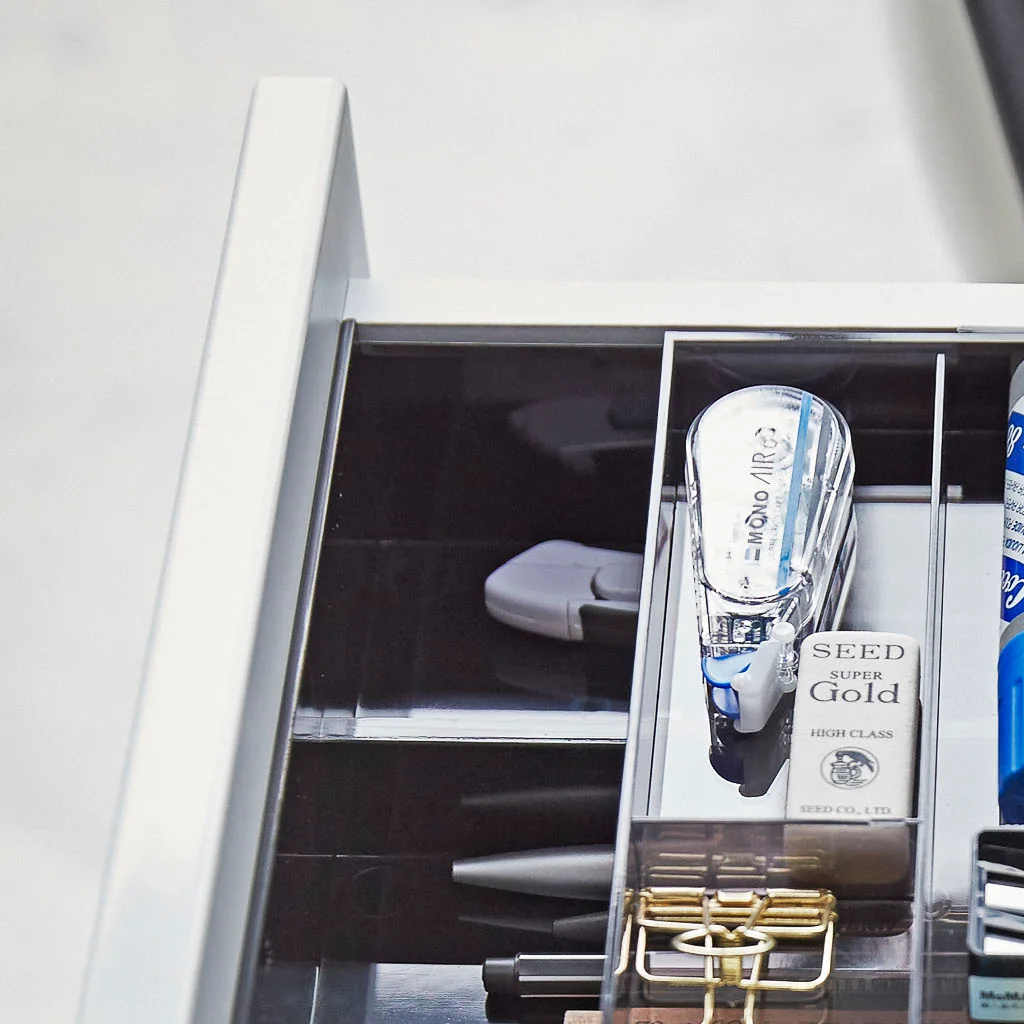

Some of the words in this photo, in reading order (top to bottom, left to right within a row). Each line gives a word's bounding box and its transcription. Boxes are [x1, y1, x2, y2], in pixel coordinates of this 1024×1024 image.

[750, 452, 777, 485] AIR
[747, 490, 769, 545] MONO
[812, 643, 905, 660] SEED
[830, 671, 883, 680] SUPER
[809, 681, 900, 704] Gold
[811, 728, 845, 738] HIGH
[849, 729, 894, 739] CLASS
[800, 804, 832, 813] SEED
